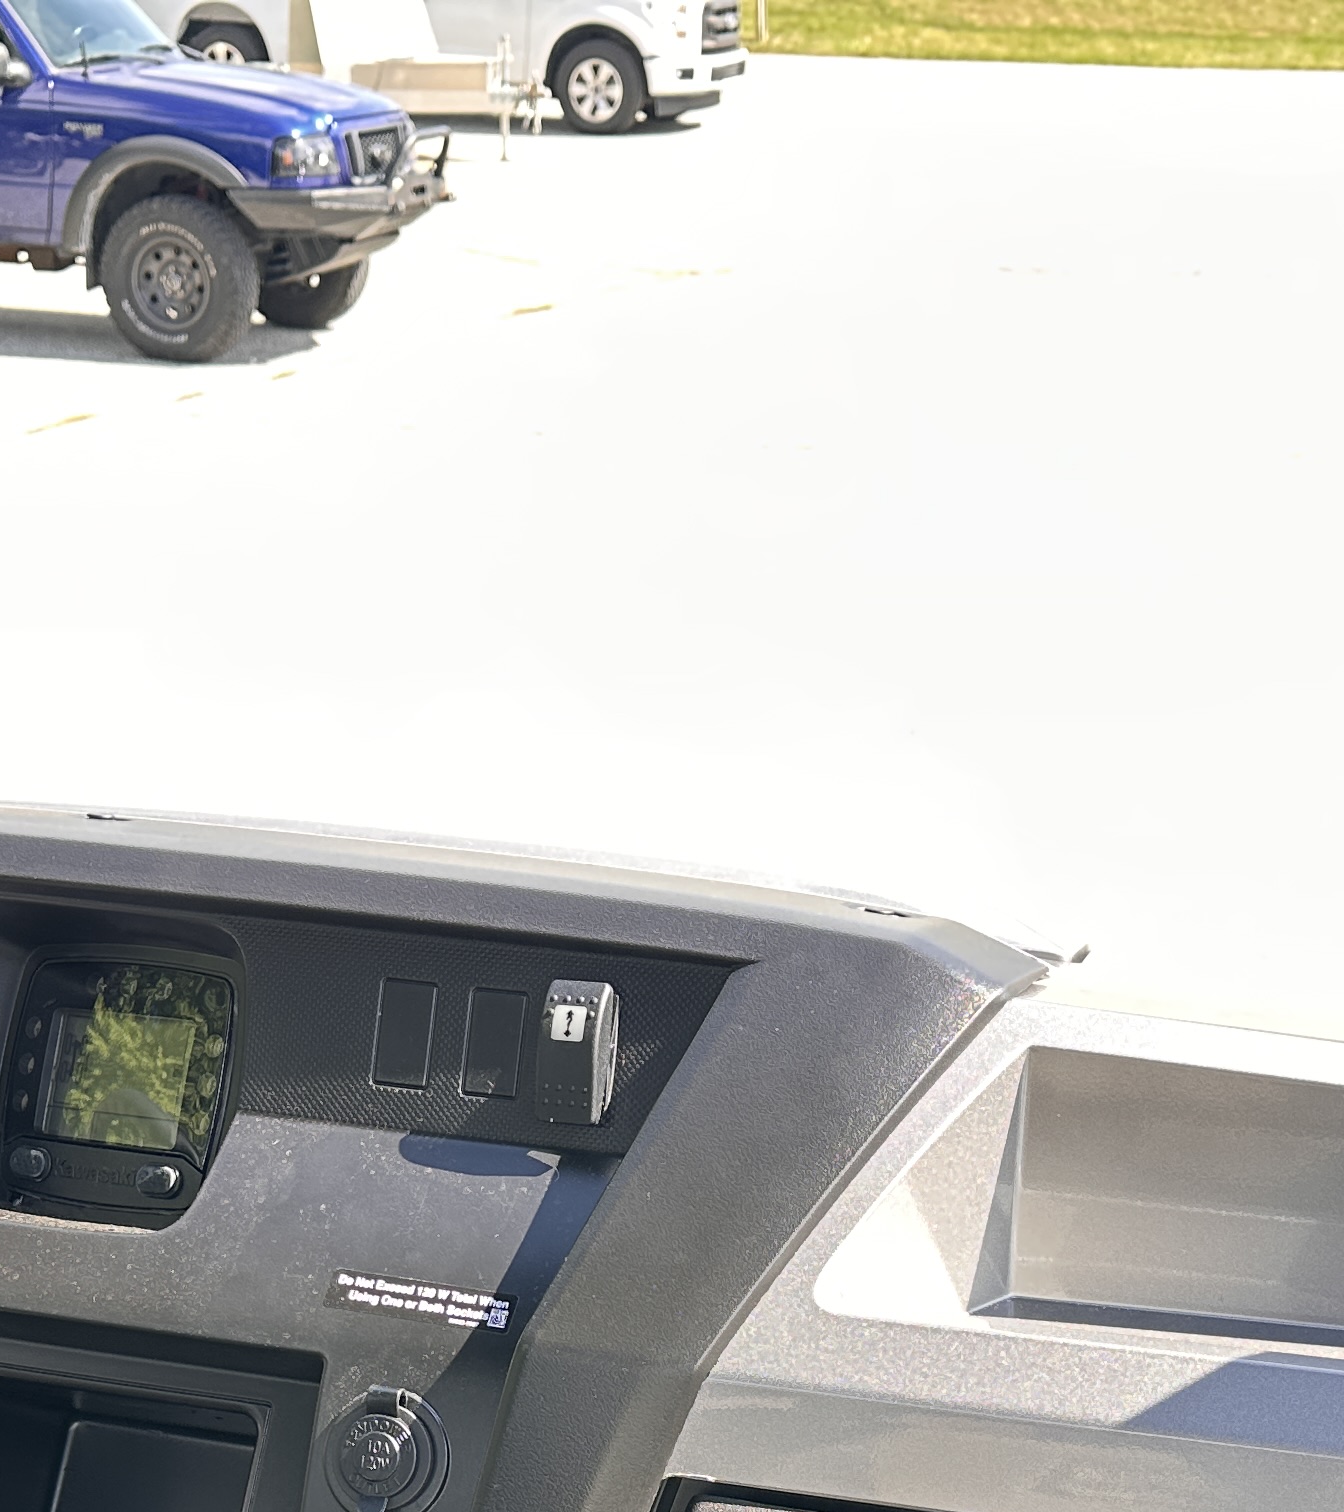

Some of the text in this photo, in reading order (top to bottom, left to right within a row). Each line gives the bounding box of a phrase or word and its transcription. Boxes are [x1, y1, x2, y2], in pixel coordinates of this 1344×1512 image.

[55, 1158, 136, 1186] Kawasaki
[337, 1273, 355, 1286] Do
[354, 1276, 375, 1289] Not
[375, 1279, 416, 1295] Exceed
[437, 1288, 451, 1300] W
[451, 1290, 478, 1305] Total
[479, 1295, 509, 1309] When
[347, 1289, 489, 1320] Using One or Both Sockets
[368, 1440, 390, 1455] 10A
[361, 1454, 391, 1470] 120W
